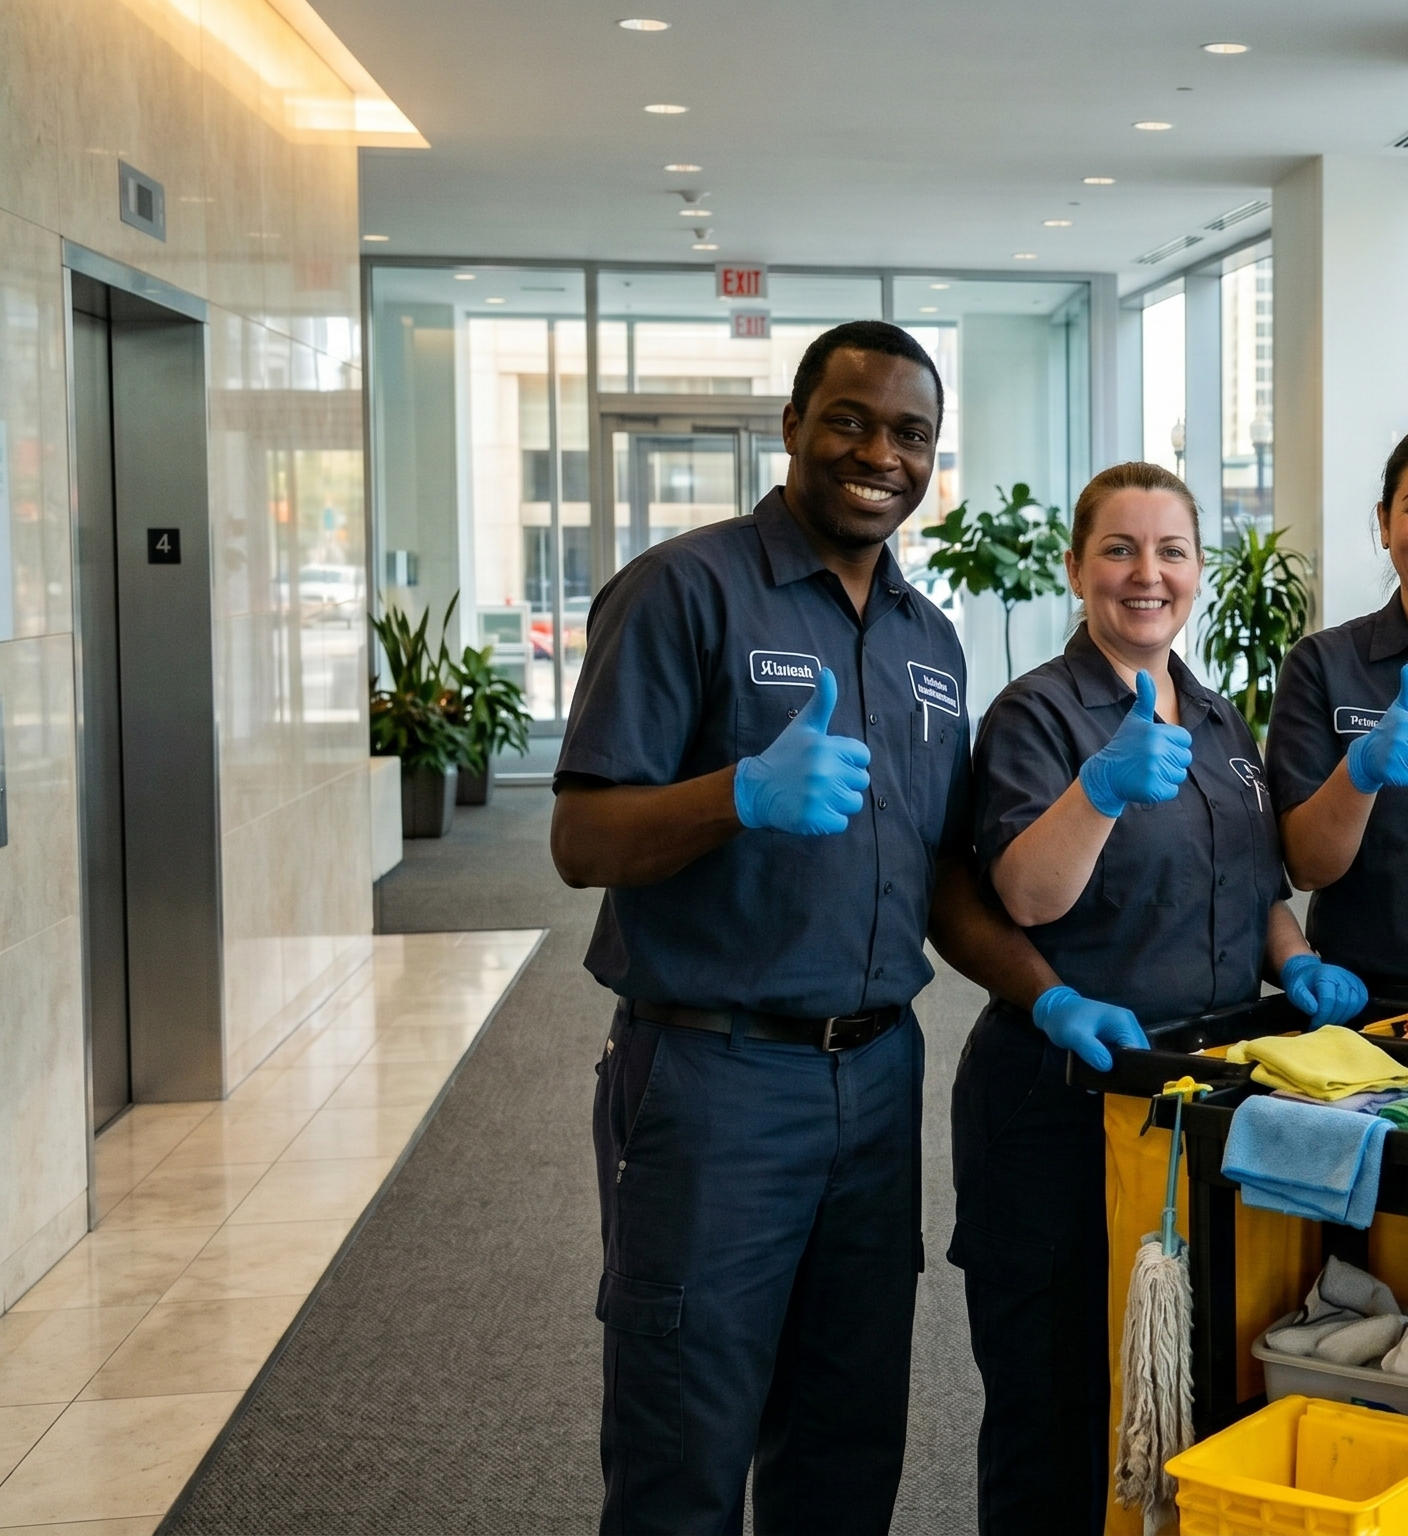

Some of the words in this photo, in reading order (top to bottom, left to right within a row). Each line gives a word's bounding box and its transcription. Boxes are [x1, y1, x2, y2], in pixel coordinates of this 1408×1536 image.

[722, 268, 761, 295] EXIT
[735, 314, 766, 336] EXIT
[155, 533, 171, 554] 4
